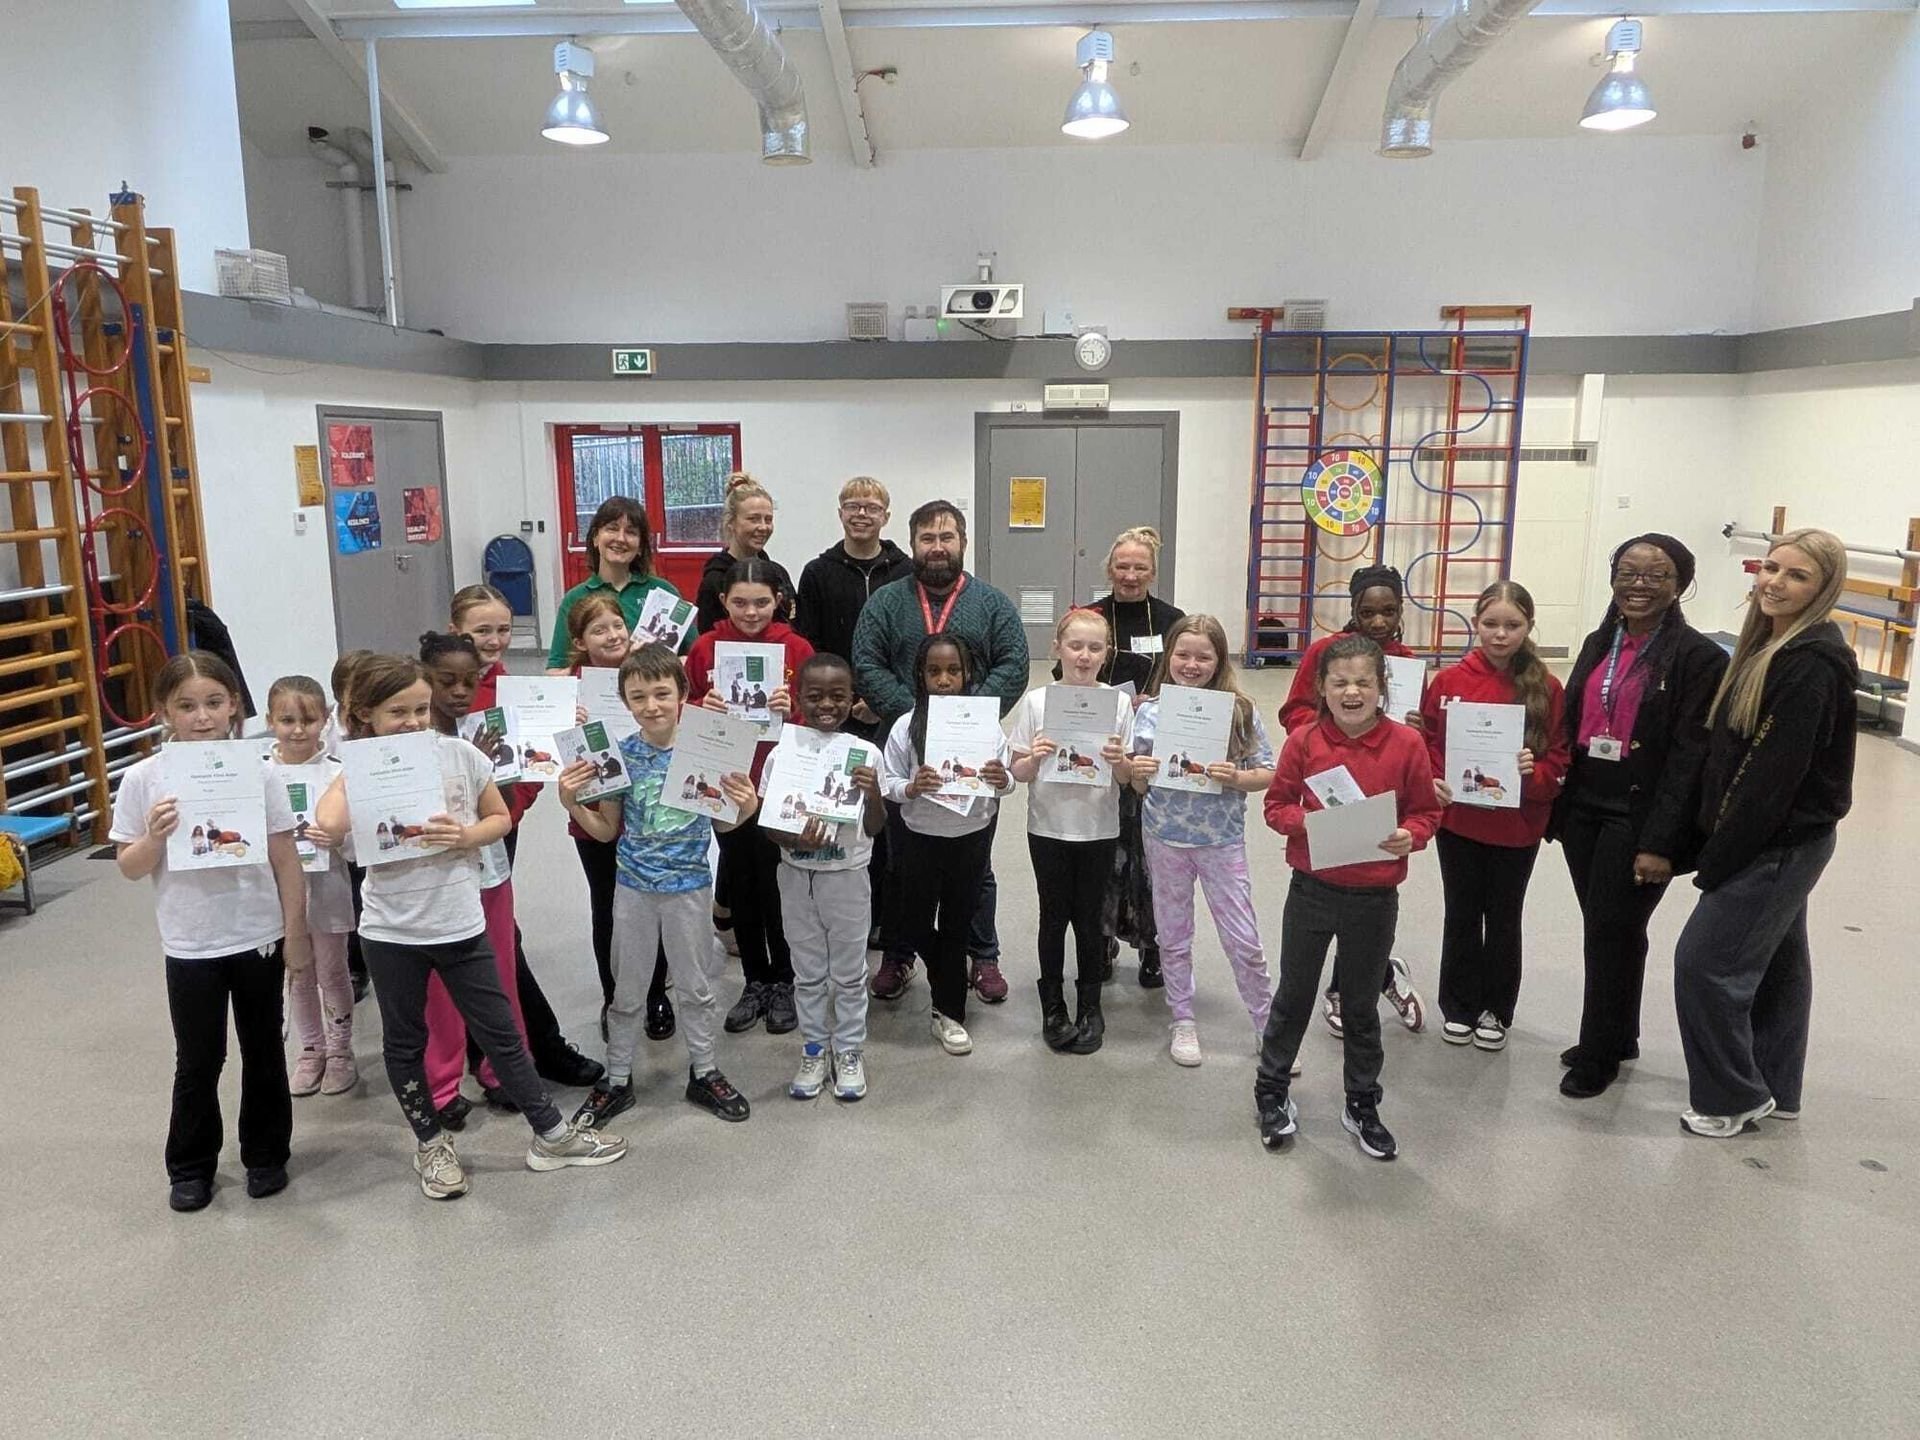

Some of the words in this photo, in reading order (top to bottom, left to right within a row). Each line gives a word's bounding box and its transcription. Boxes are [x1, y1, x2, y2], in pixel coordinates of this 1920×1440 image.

[1308, 472, 1318, 480] 10
[1307, 498, 1315, 506] 10
[1326, 520, 1335, 528] 10
